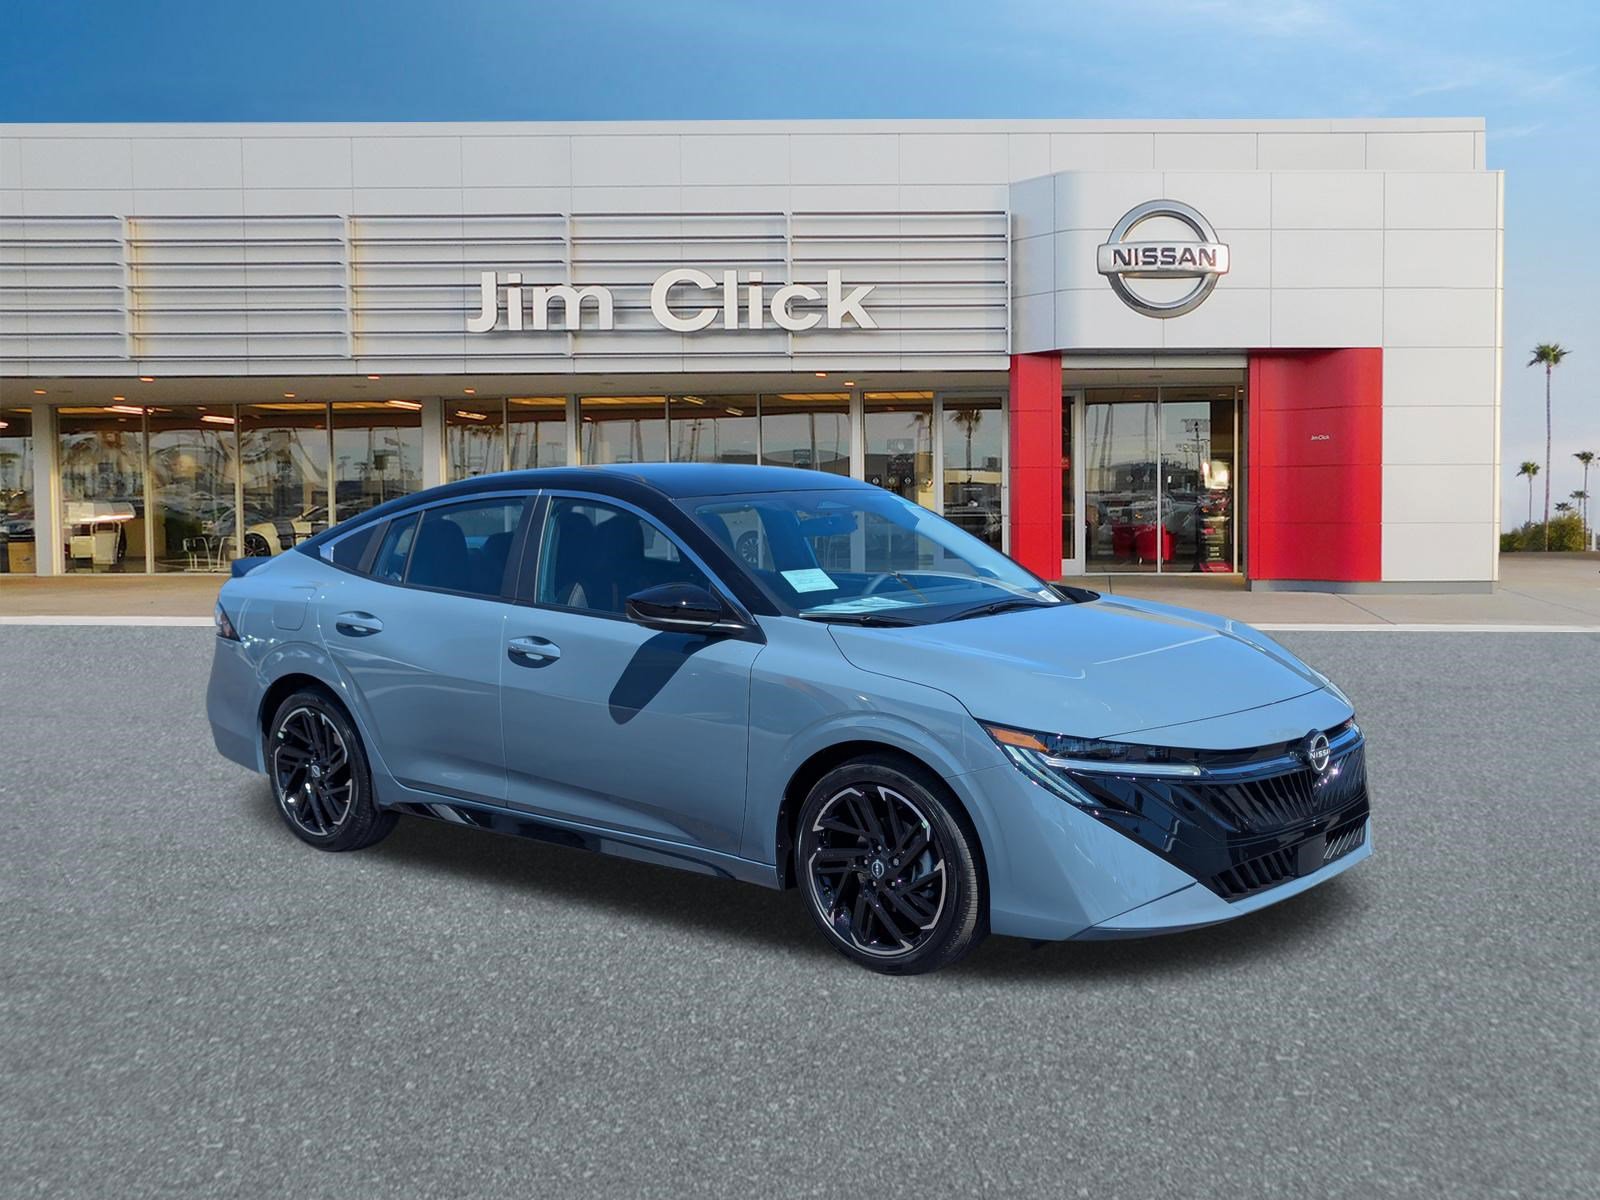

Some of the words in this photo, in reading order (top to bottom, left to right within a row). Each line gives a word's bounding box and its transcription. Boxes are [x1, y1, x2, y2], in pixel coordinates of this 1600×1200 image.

[1112, 247, 1217, 267] NISSAN
[467, 270, 614, 333] Jim
[650, 268, 879, 333] Click
